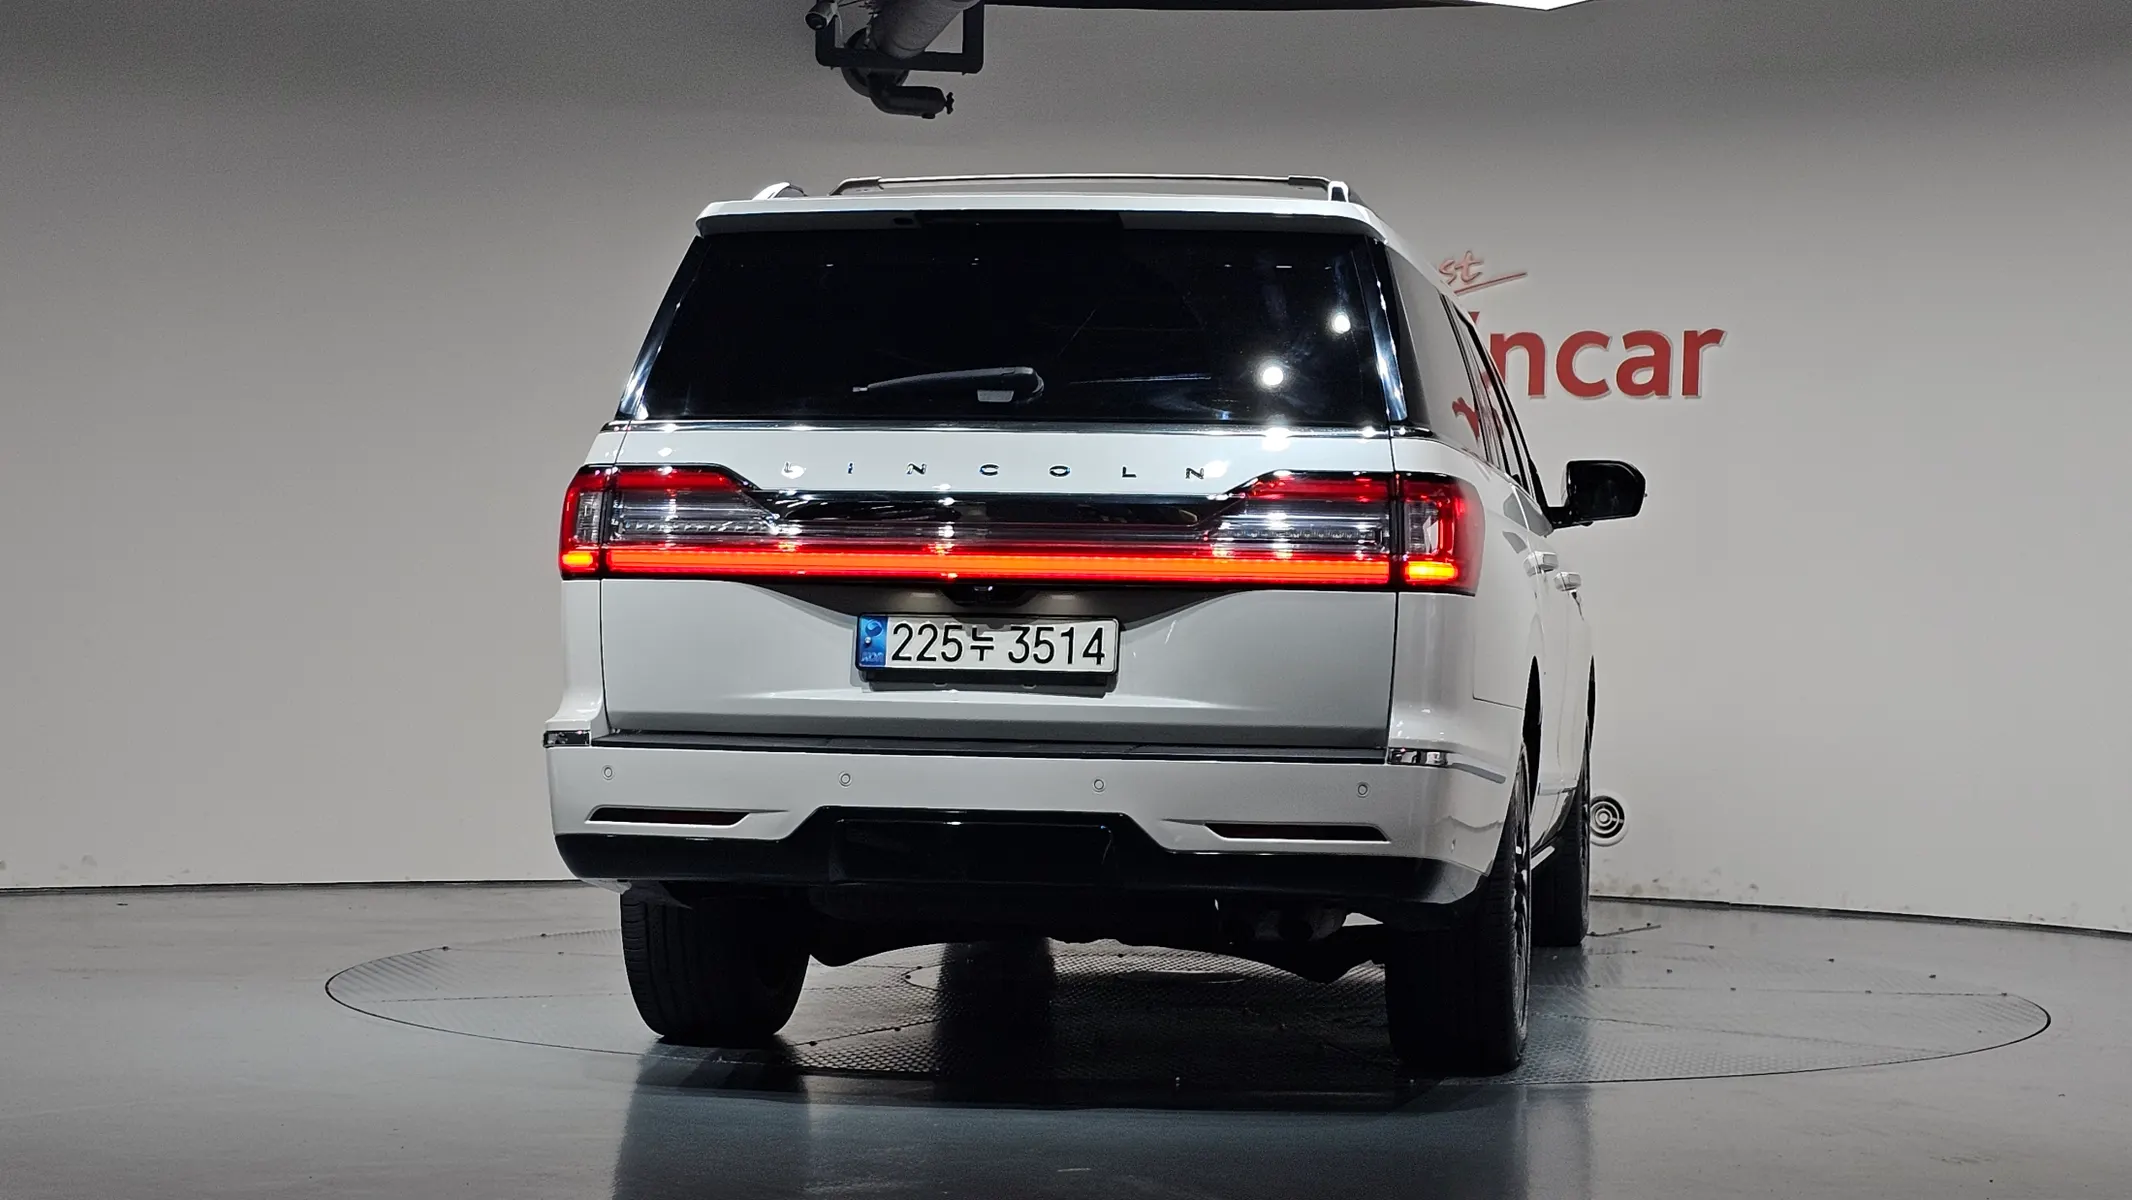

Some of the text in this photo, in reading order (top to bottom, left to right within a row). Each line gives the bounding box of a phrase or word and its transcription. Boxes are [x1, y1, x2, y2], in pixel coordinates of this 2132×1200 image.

[1467, 311, 1725, 398] ncar
[783, 461, 1204, 480] LINCOLN
[891, 622, 1106, 665] 225누 3514
